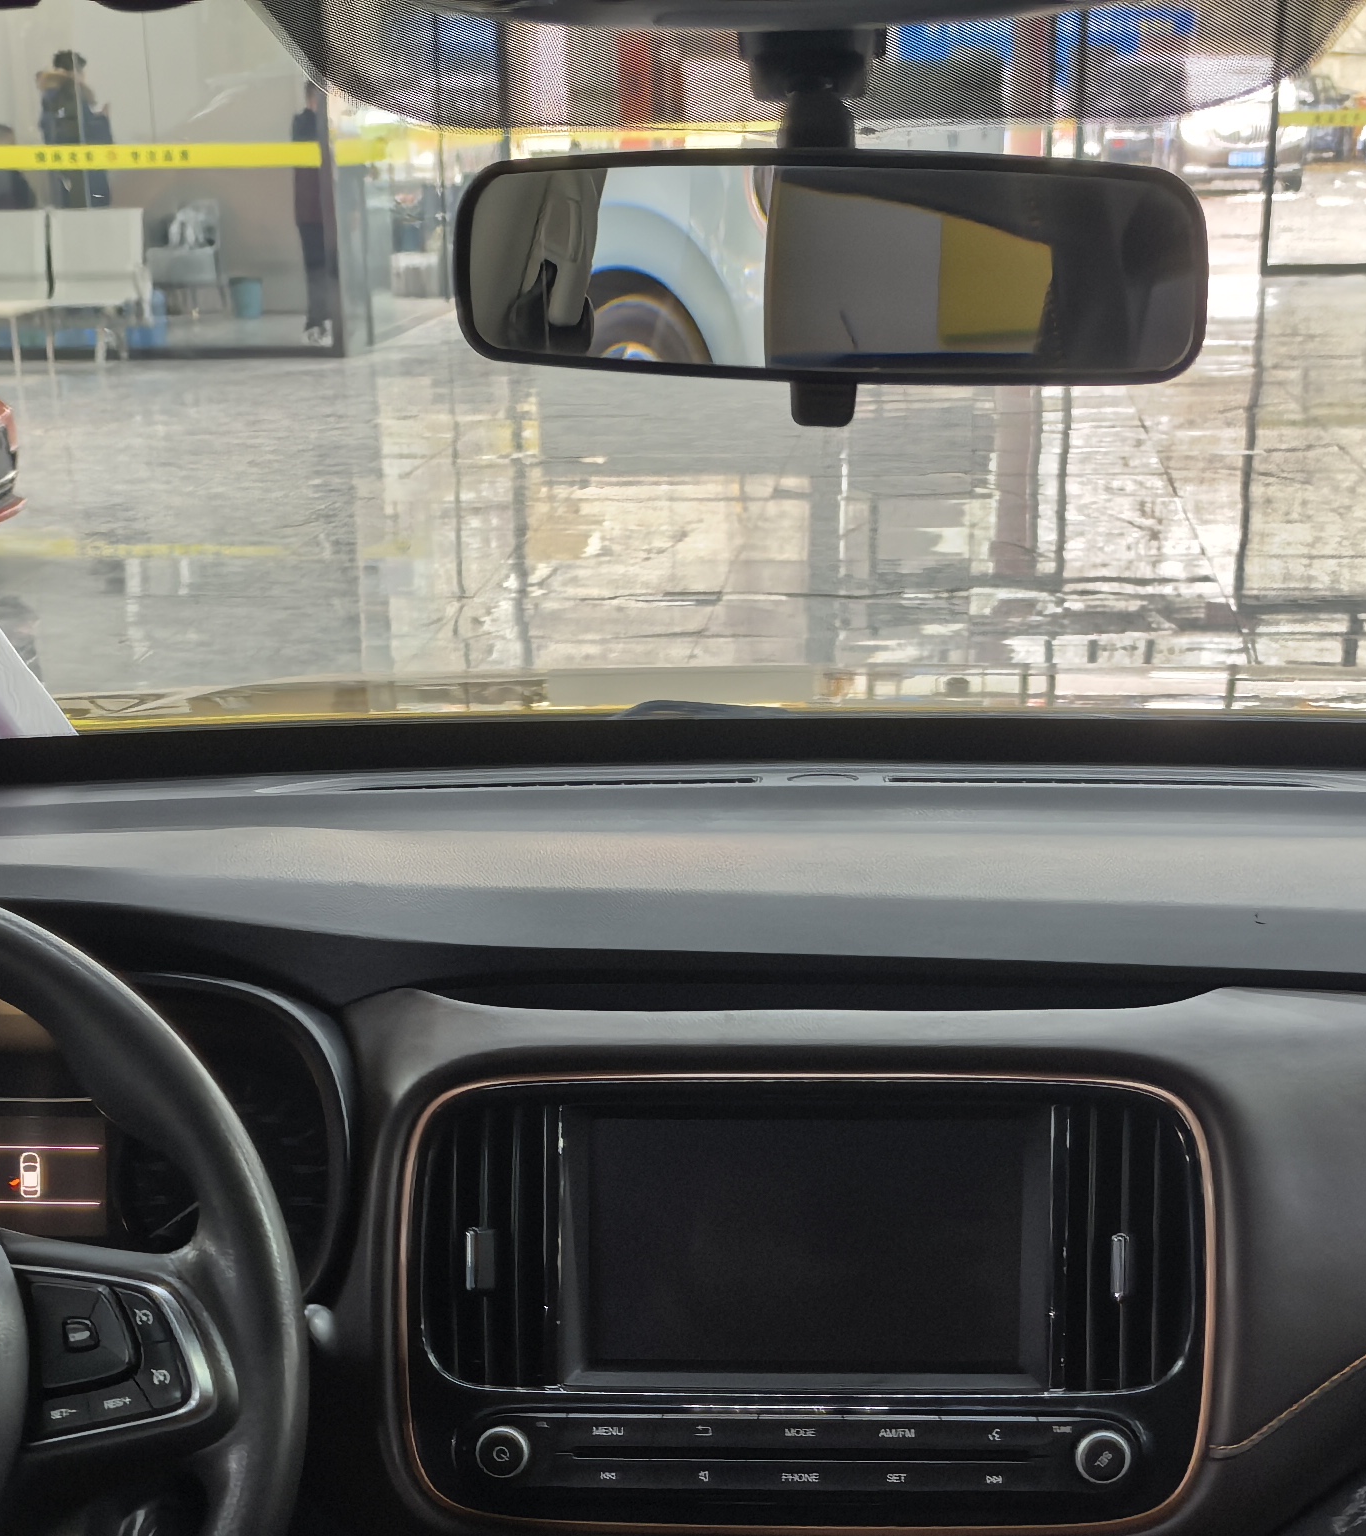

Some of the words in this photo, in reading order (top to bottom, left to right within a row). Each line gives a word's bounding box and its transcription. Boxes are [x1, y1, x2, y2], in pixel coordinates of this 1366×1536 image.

[592, 1426, 624, 1436] MENU
[784, 1428, 817, 1437] MODE
[878, 1428, 916, 1438] AM/FM
[781, 1472, 820, 1483] PHONE
[886, 1473, 907, 1483] SET
